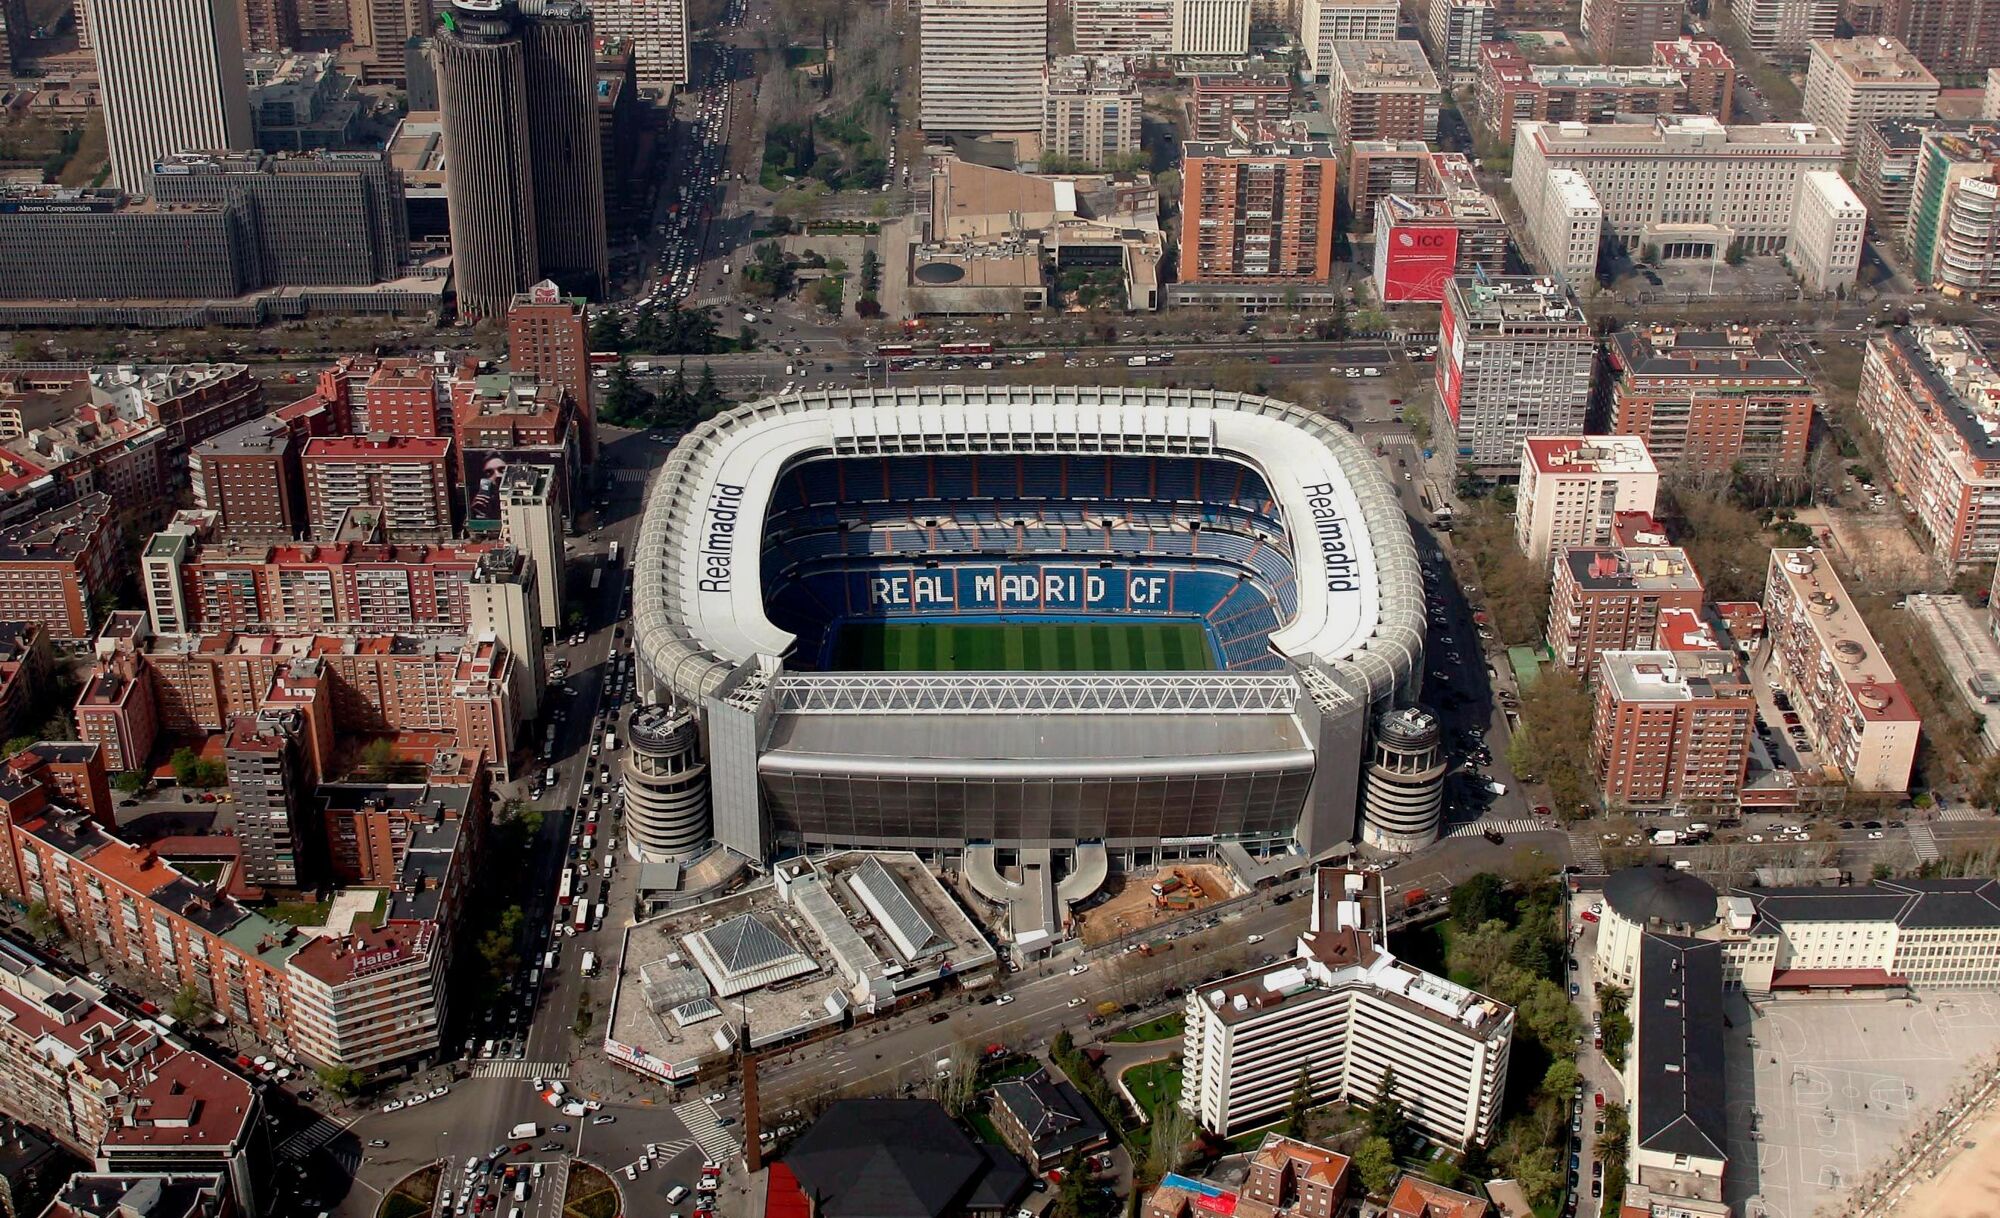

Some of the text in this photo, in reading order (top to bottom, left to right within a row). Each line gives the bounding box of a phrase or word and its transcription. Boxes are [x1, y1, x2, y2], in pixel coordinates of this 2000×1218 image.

[541, 8, 569, 17] KPMG
[1963, 178, 1996, 193] TISCALI
[19, 204, 92, 213] Ahorro Corporación
[1417, 235, 1444, 247] ICC
[871, 576, 953, 604] REAL
[975, 575, 1104, 602] MADRID
[353, 949, 400, 969] Haier
